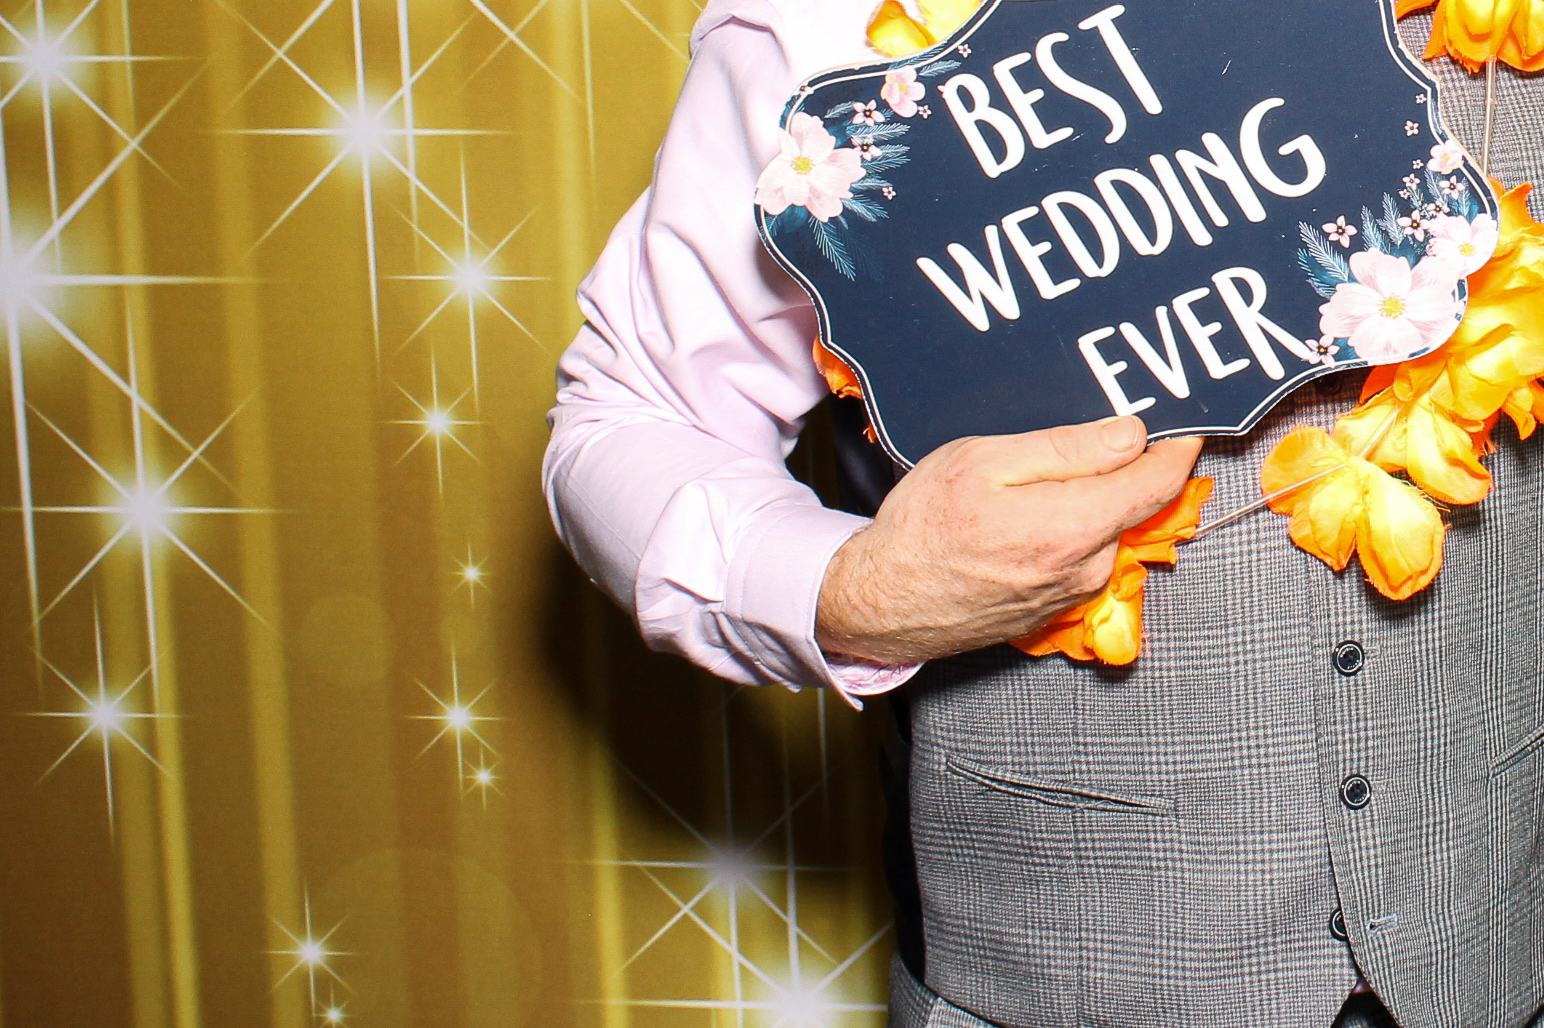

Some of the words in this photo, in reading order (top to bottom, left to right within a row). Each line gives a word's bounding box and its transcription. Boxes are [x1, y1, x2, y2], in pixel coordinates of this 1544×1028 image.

[944, 5, 1162, 178] BEST
[917, 98, 1327, 331] WEDDING
[1077, 268, 1312, 417] EVER
